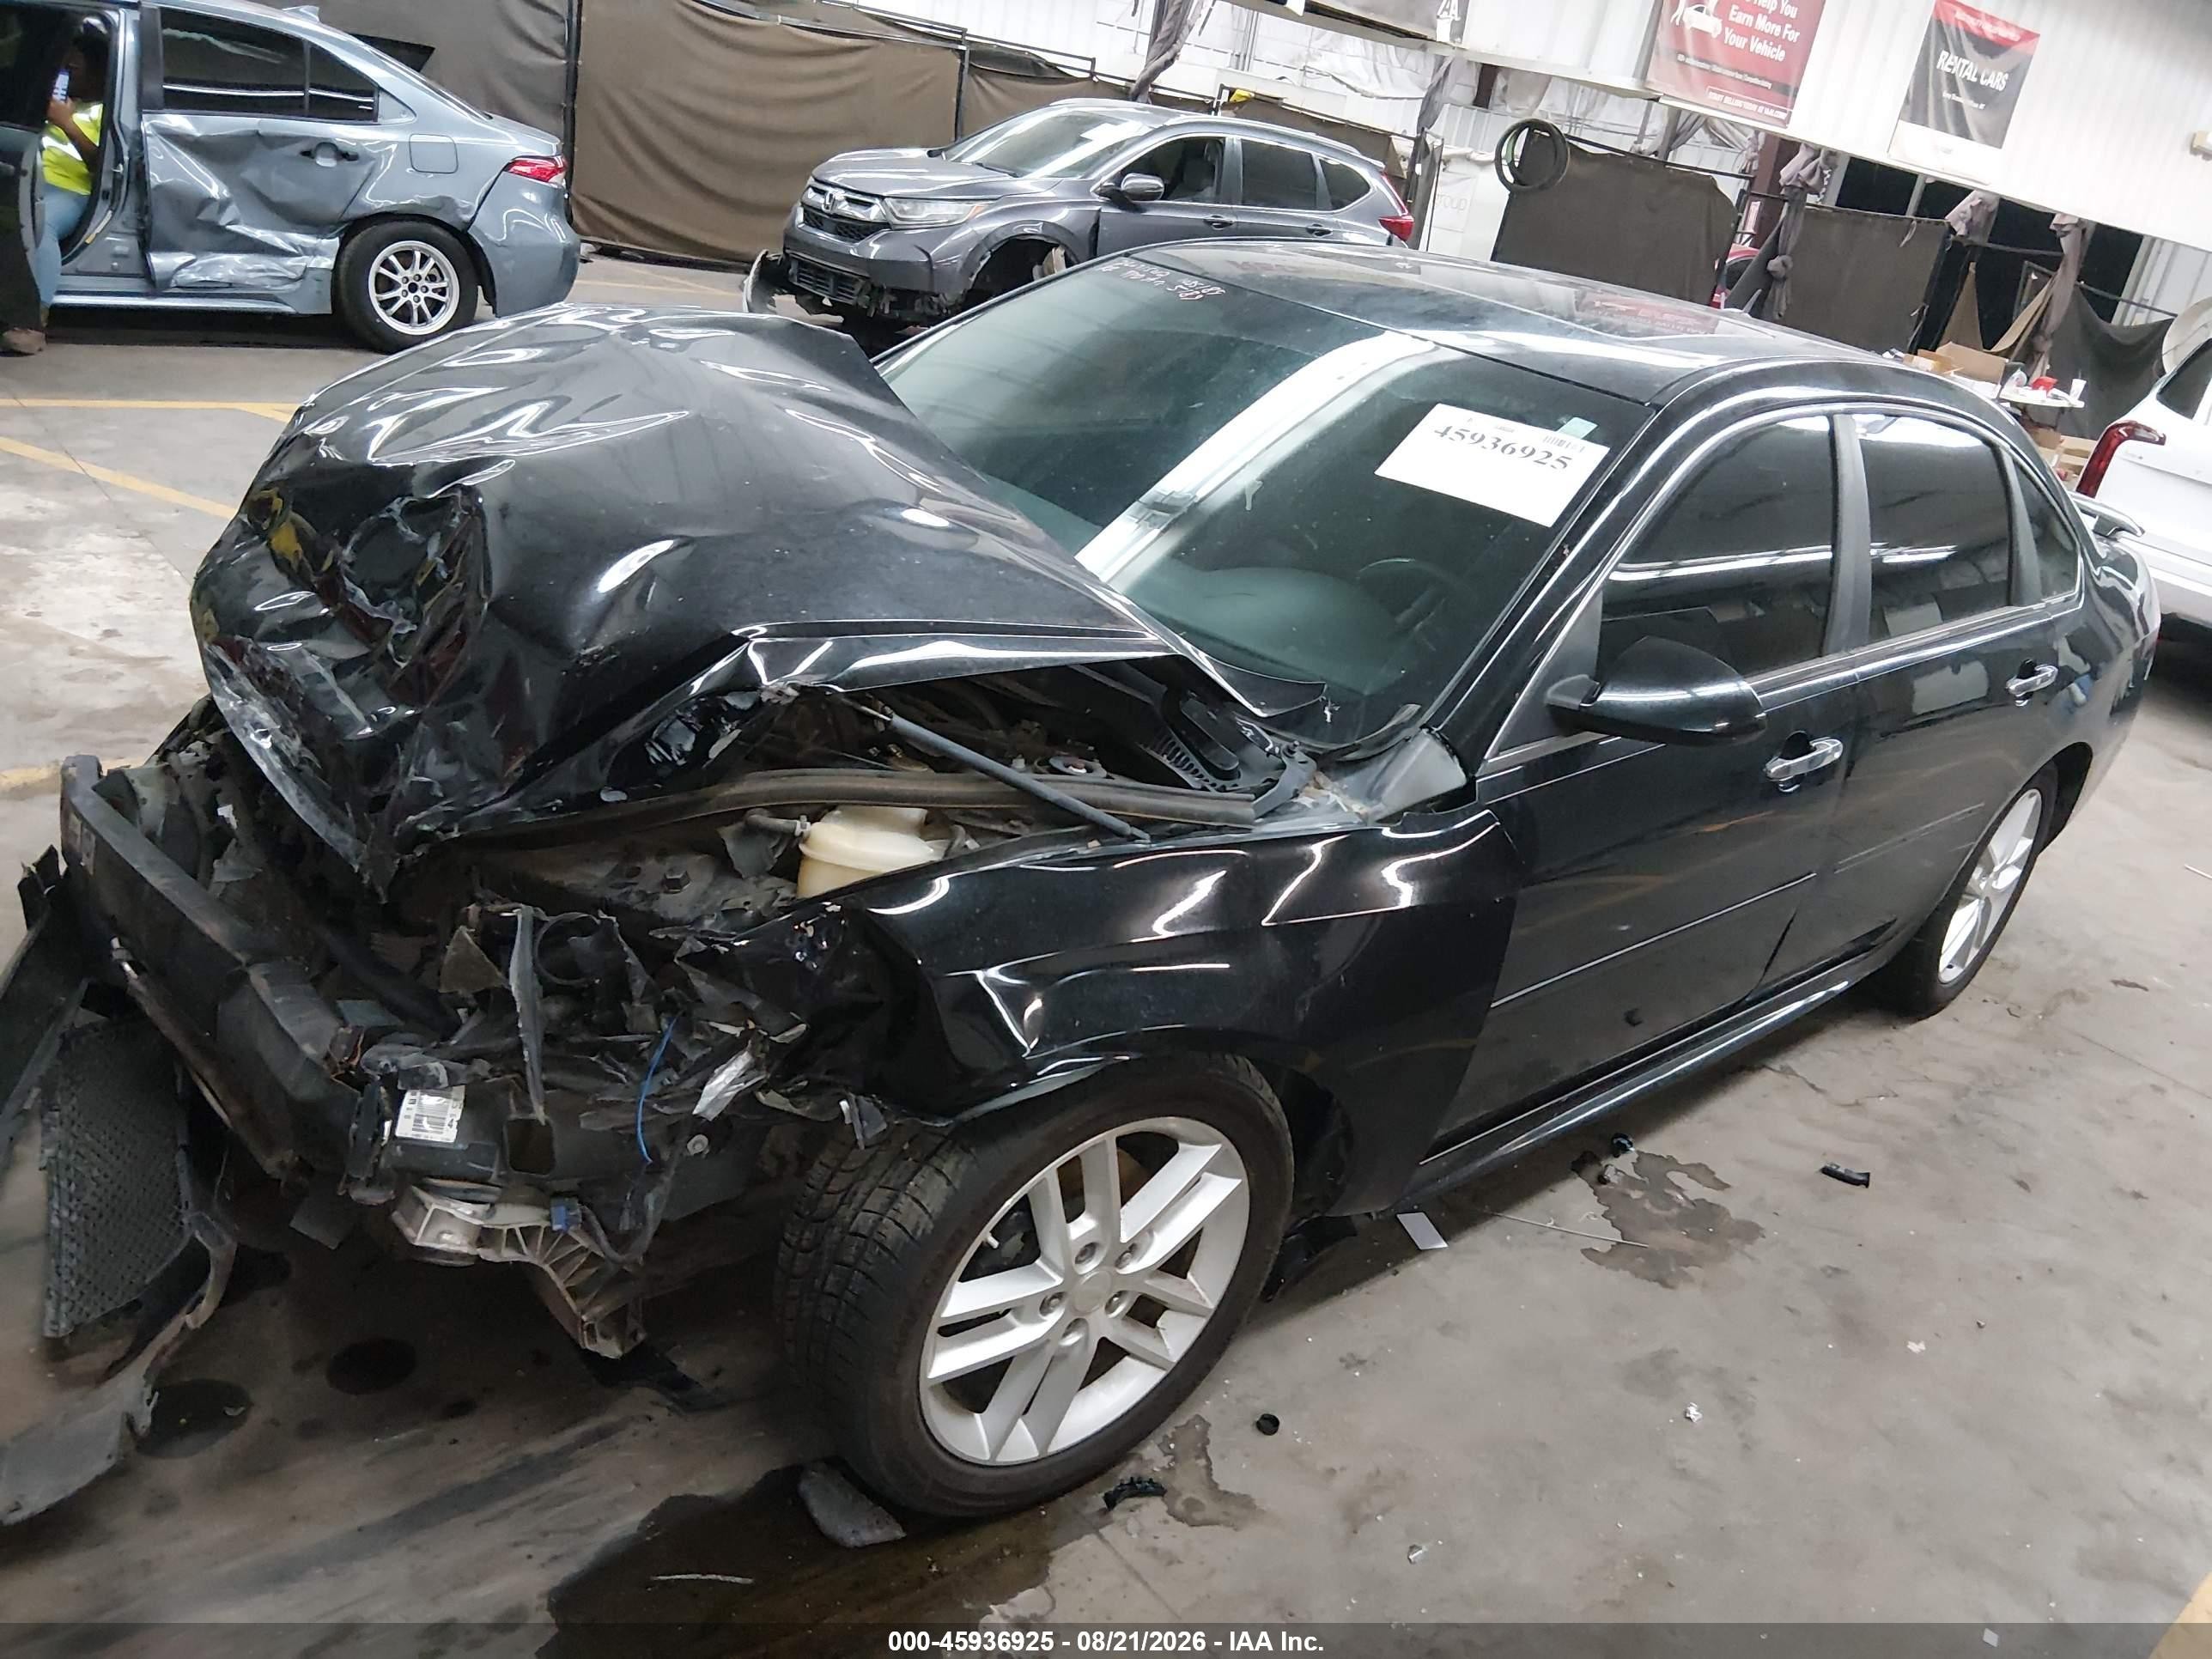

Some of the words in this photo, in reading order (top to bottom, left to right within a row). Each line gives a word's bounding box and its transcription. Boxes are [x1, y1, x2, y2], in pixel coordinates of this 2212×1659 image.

[1729, 4, 1753, 27] Earn
[1754, 13, 1782, 36] More
[1782, 23, 1800, 43] For
[1779, 0, 1798, 18] You
[1724, 27, 1748, 49] Your
[1749, 35, 1785, 62] Vehicle
[1936, 50, 1978, 82] RENTAL
[1979, 69, 2008, 91] CARS
[1433, 425, 1572, 470] 45936925
